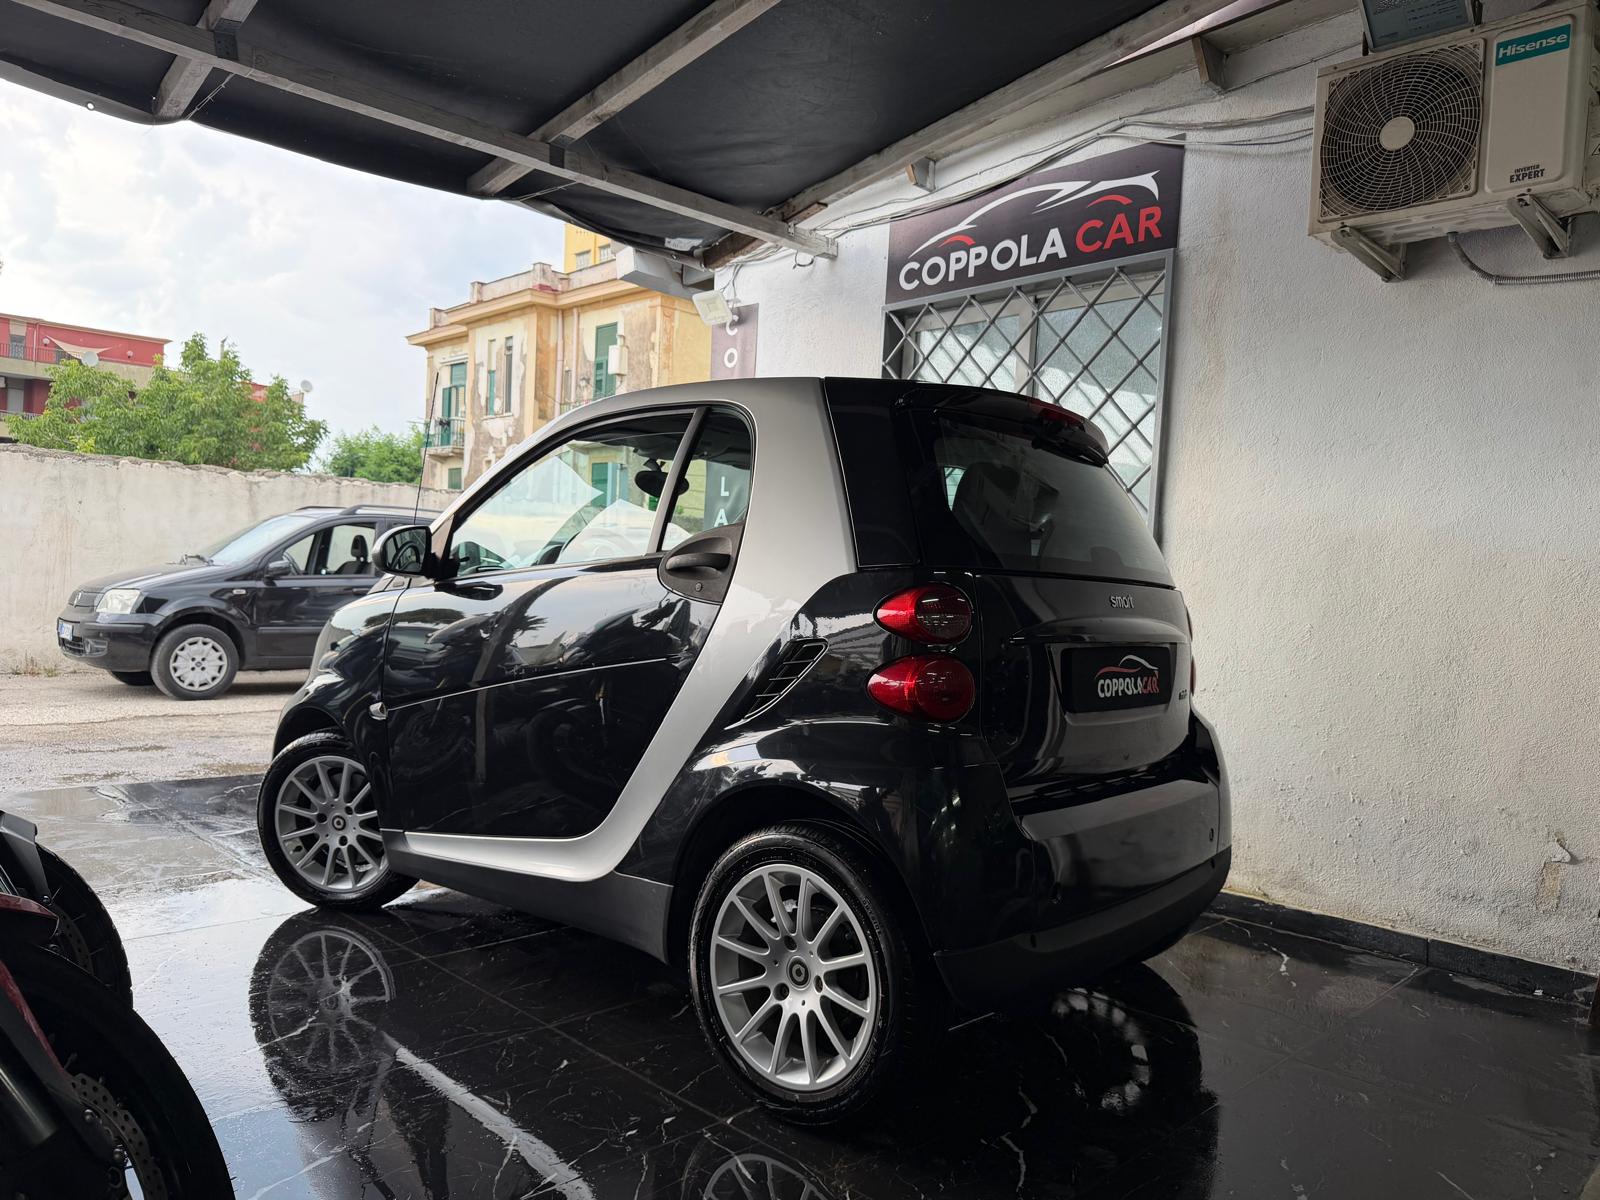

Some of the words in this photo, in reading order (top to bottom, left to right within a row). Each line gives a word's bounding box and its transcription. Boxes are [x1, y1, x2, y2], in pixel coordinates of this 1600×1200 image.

[1498, 33, 1568, 58] Hisense
[1509, 168, 1545, 184] EXPERT
[1514, 164, 1540, 174] INVERTER
[899, 227, 1067, 291] COPPOLA
[1075, 206, 1162, 253] CAR
[1110, 594, 1135, 609] smart
